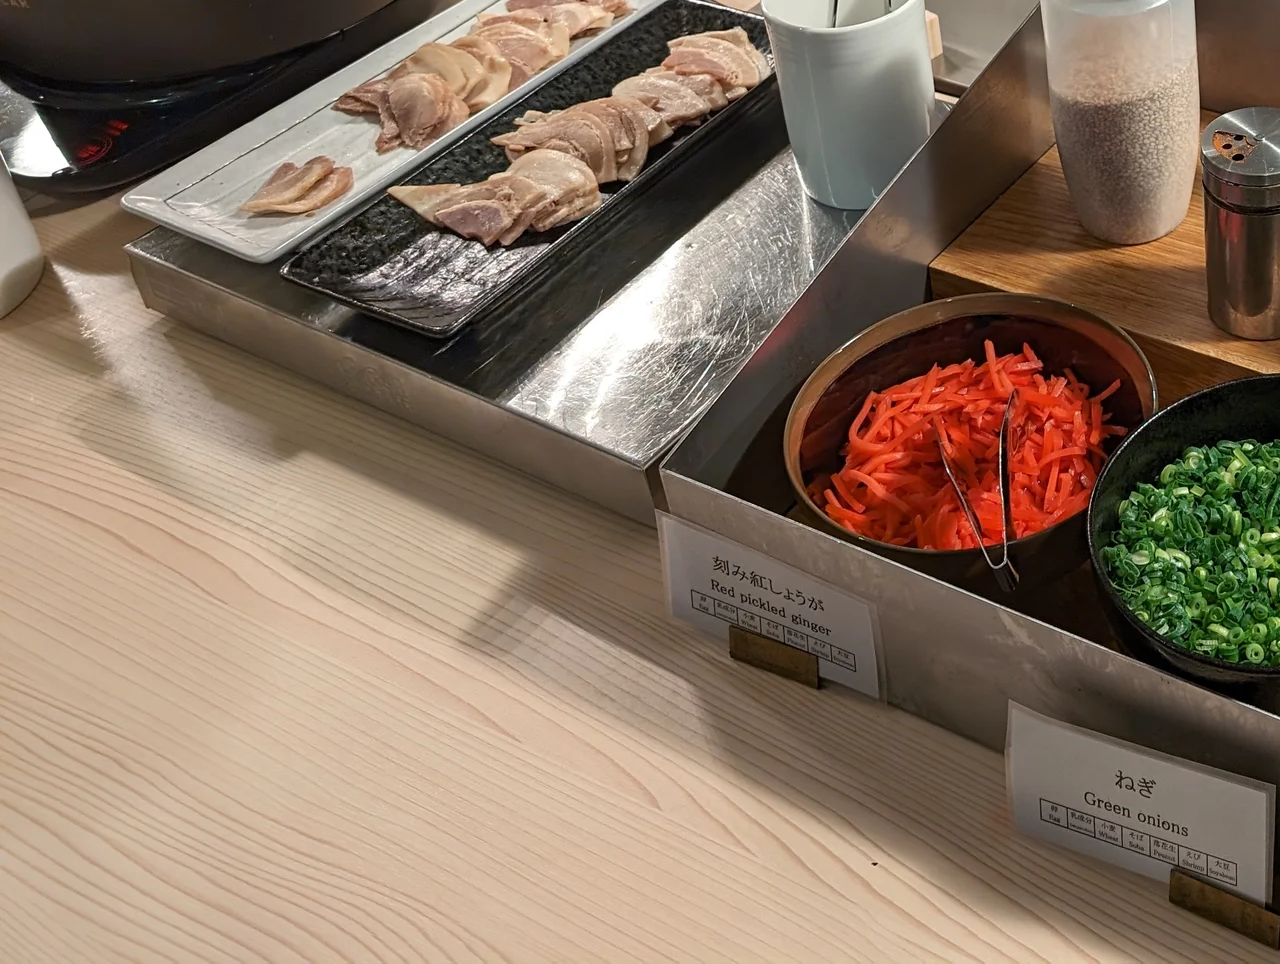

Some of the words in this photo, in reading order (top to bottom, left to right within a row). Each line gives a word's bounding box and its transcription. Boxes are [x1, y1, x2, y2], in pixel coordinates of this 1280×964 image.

[712, 555, 825, 612] 刻み紅しょうが
[711, 579, 736, 598] Red
[740, 593, 787, 618] pickled
[791, 613, 832, 637] ginger
[1114, 769, 1157, 799] ねぎ
[1084, 791, 1132, 819] Green
[1137, 811, 1190, 837] onions
[1129, 831, 1144, 842] そば
[1186, 850, 1201, 861] えび
